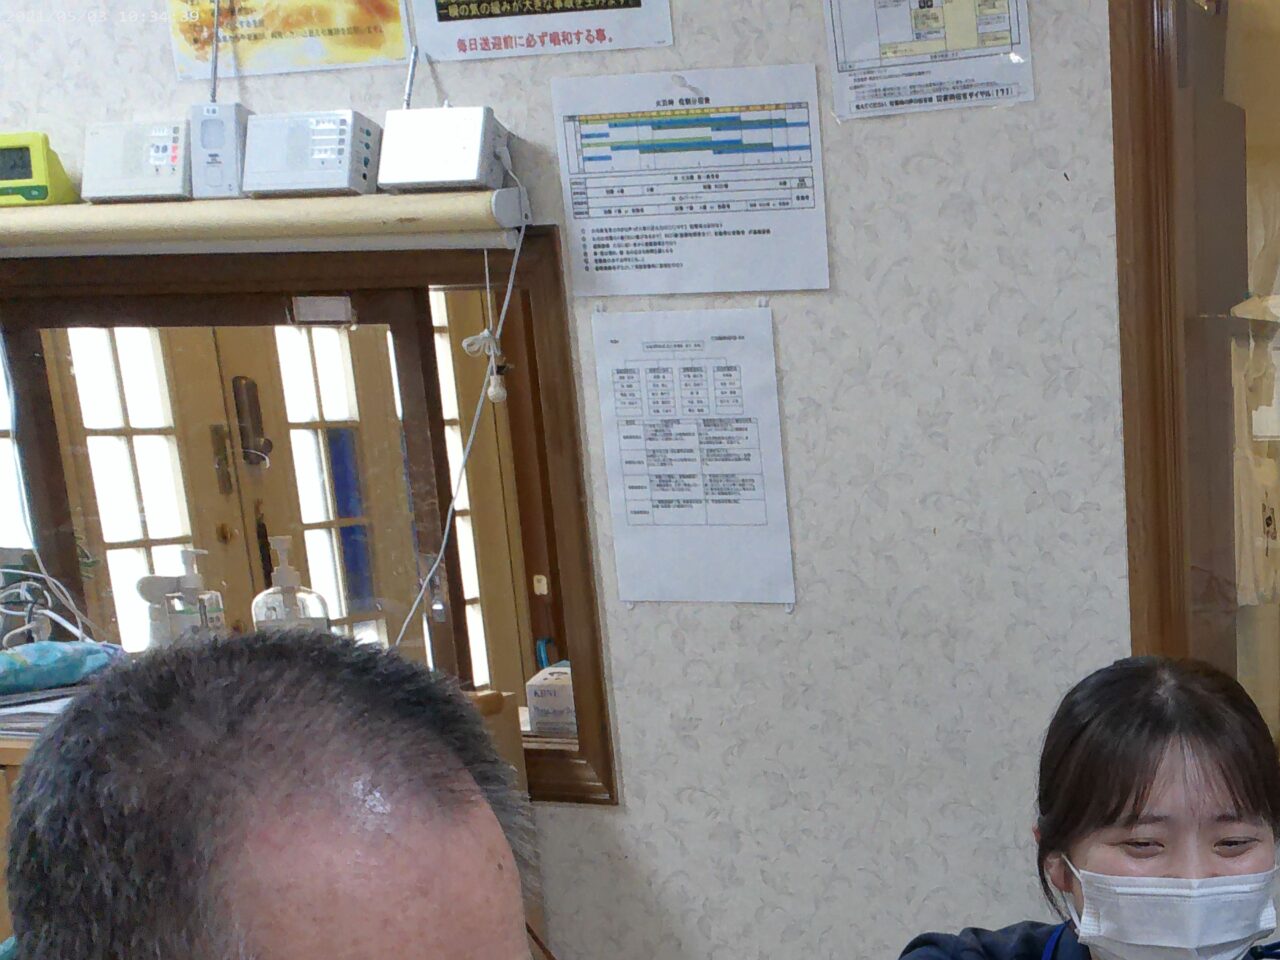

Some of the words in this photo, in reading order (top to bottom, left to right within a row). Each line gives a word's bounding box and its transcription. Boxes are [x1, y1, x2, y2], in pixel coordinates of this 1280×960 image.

[457, 28, 613, 53] 毎日送迎前に必ず唱和する事。
